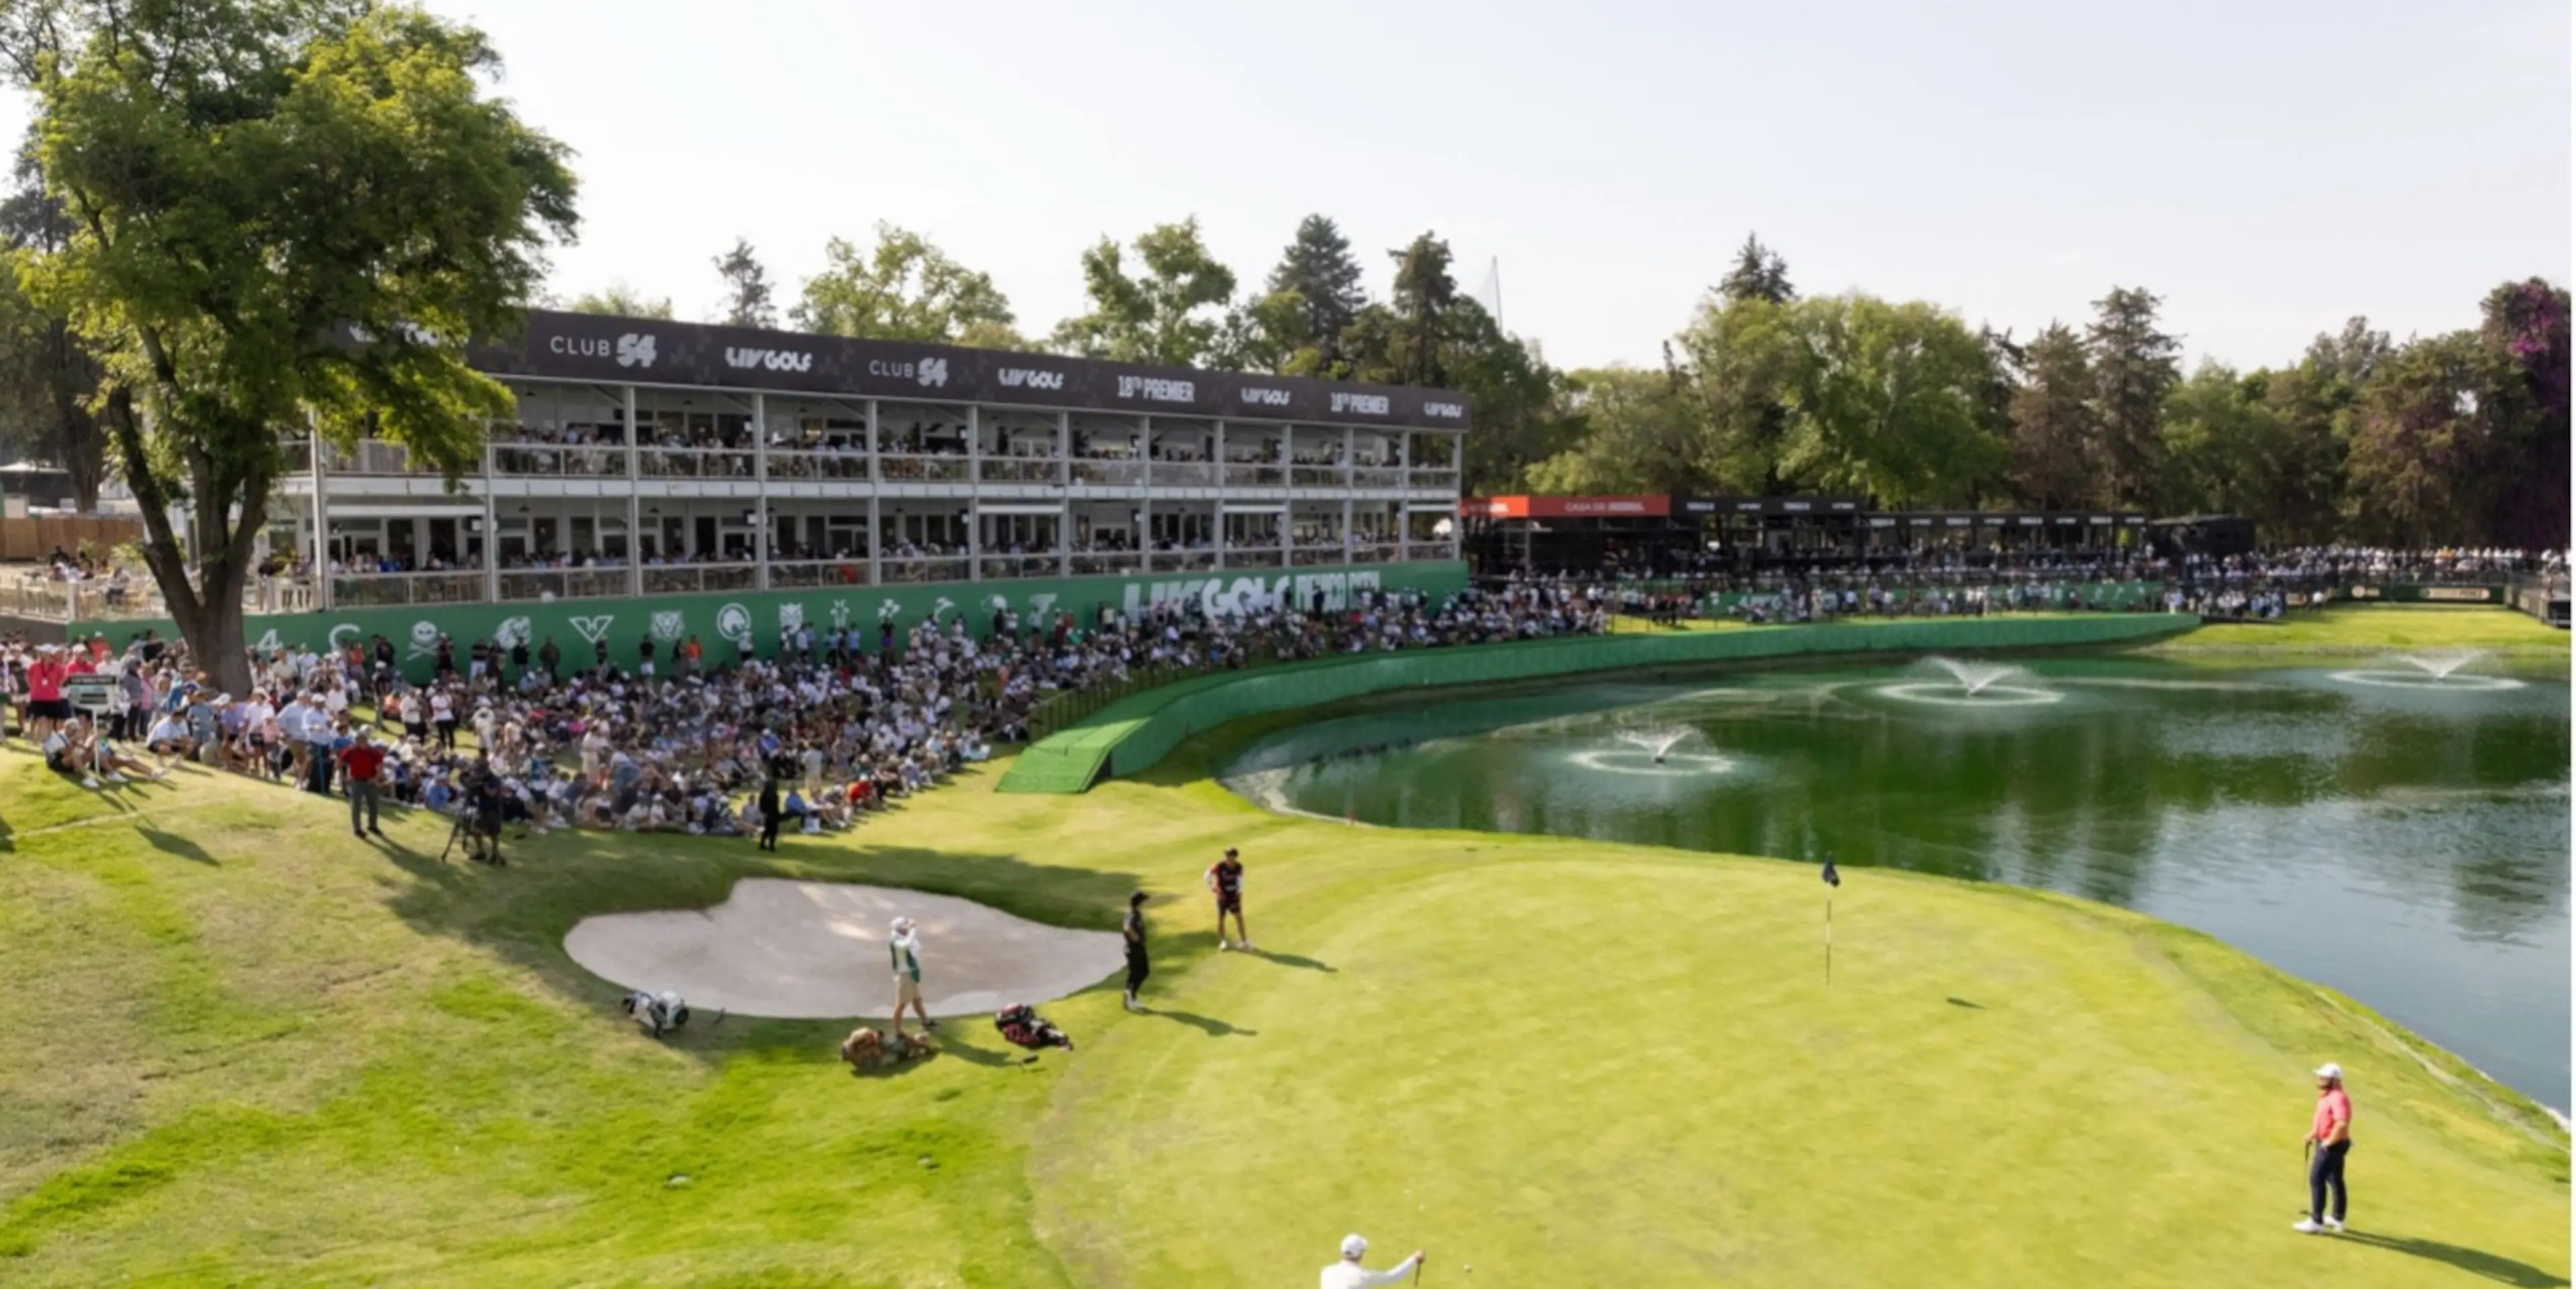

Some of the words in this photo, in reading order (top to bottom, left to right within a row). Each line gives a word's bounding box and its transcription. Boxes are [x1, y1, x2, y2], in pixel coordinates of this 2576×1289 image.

[550, 335, 610, 357] CLUB
[616, 333, 657, 368] 54
[869, 359, 913, 378] CLUB
[918, 357, 948, 387] 54
